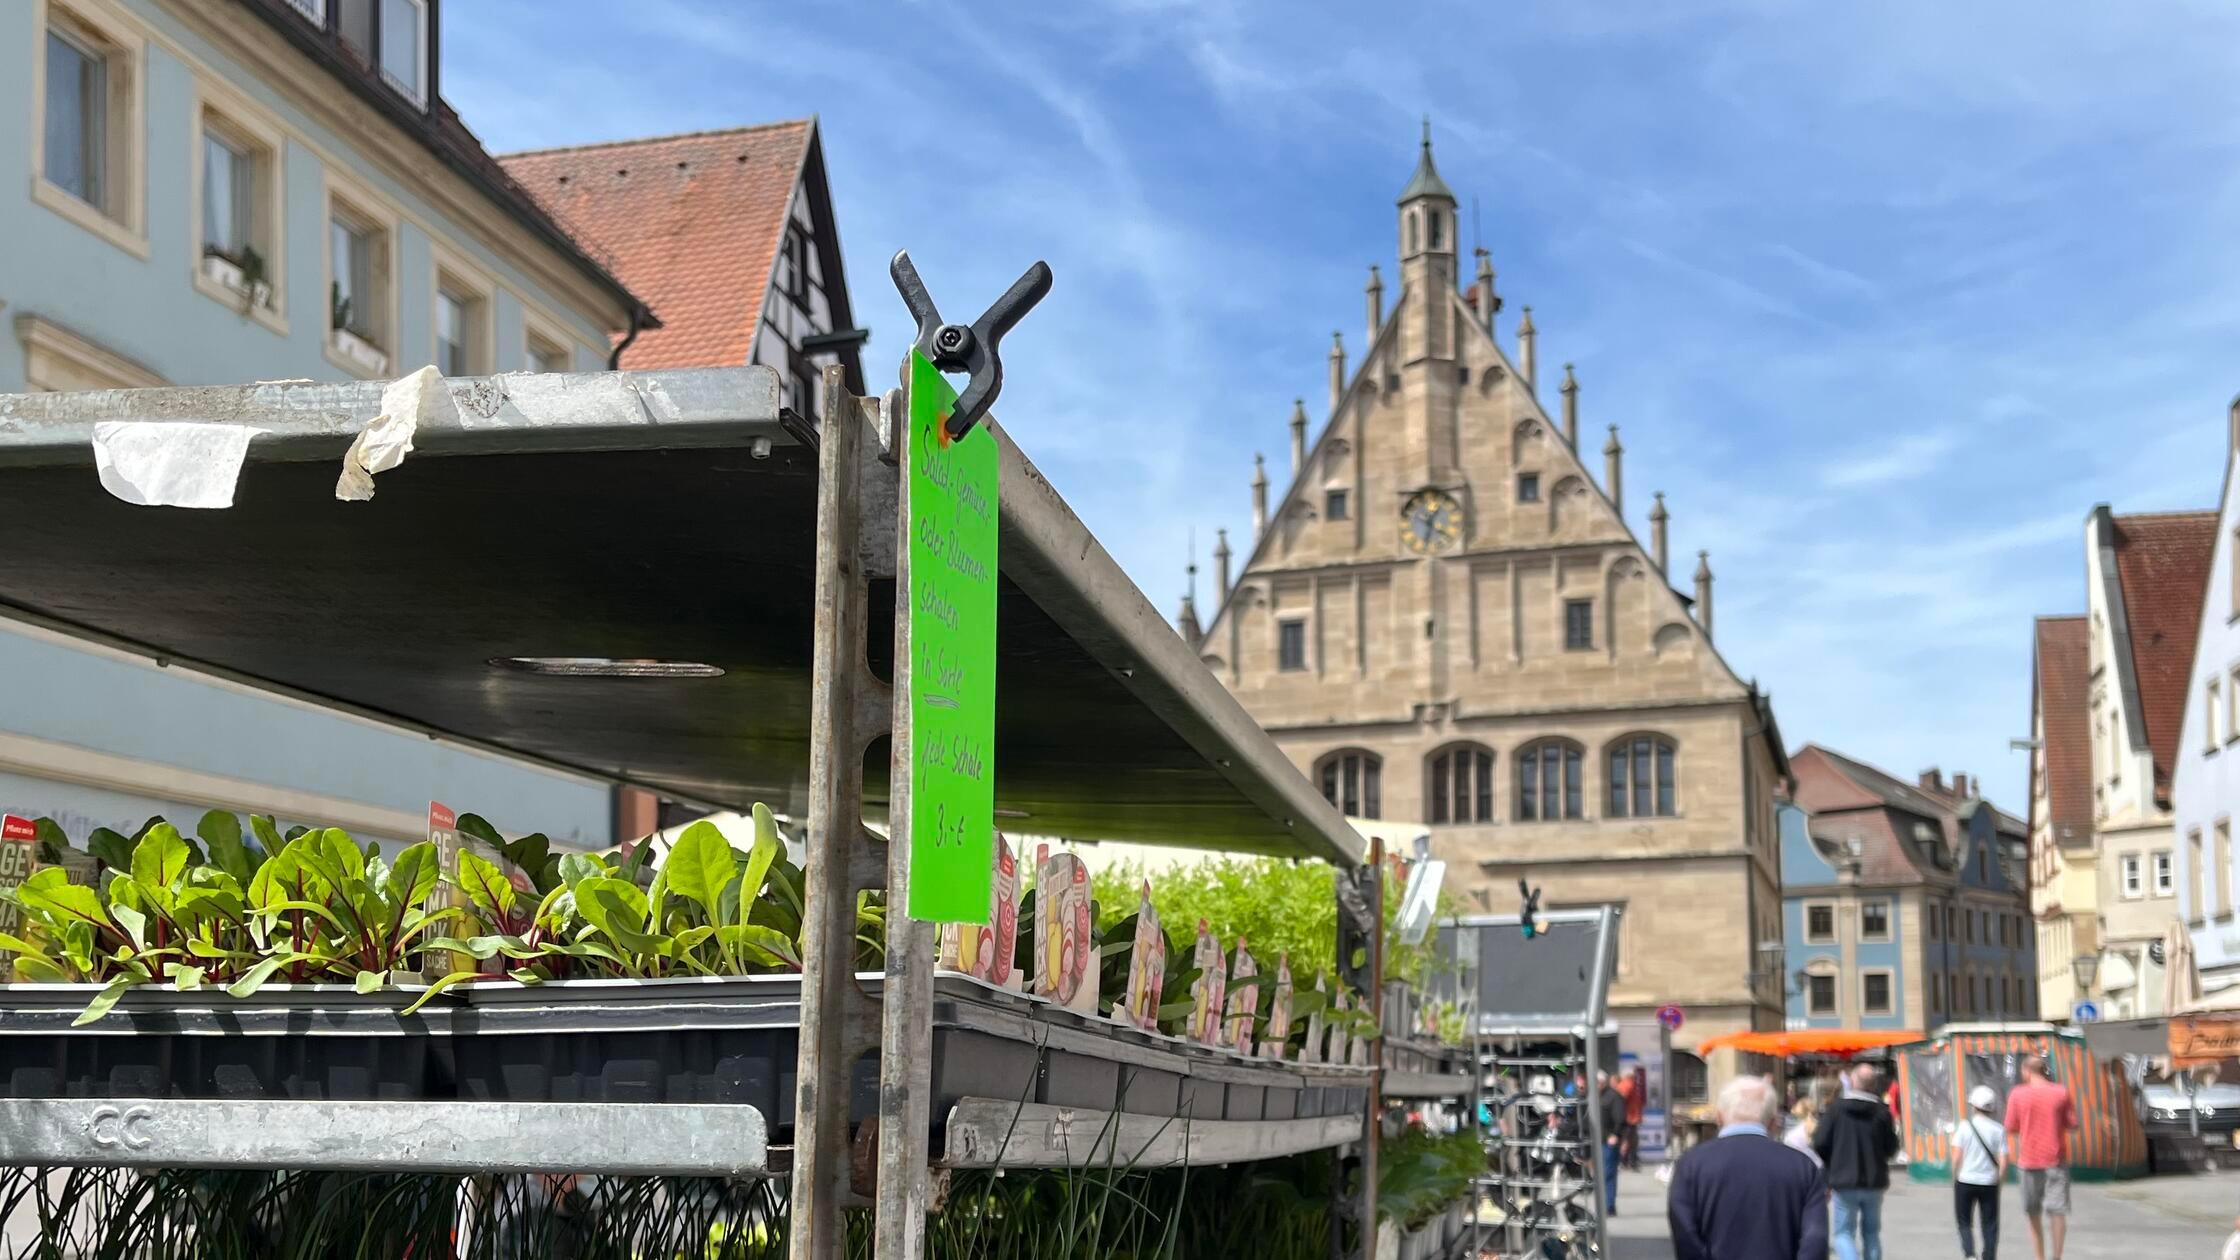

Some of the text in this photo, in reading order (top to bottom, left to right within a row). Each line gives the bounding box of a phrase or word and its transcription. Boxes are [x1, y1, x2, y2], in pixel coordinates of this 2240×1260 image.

[920, 513, 944, 560] oder
[921, 641, 931, 680] in
[921, 729, 946, 792] jede
[1, 842, 32, 877] GE
